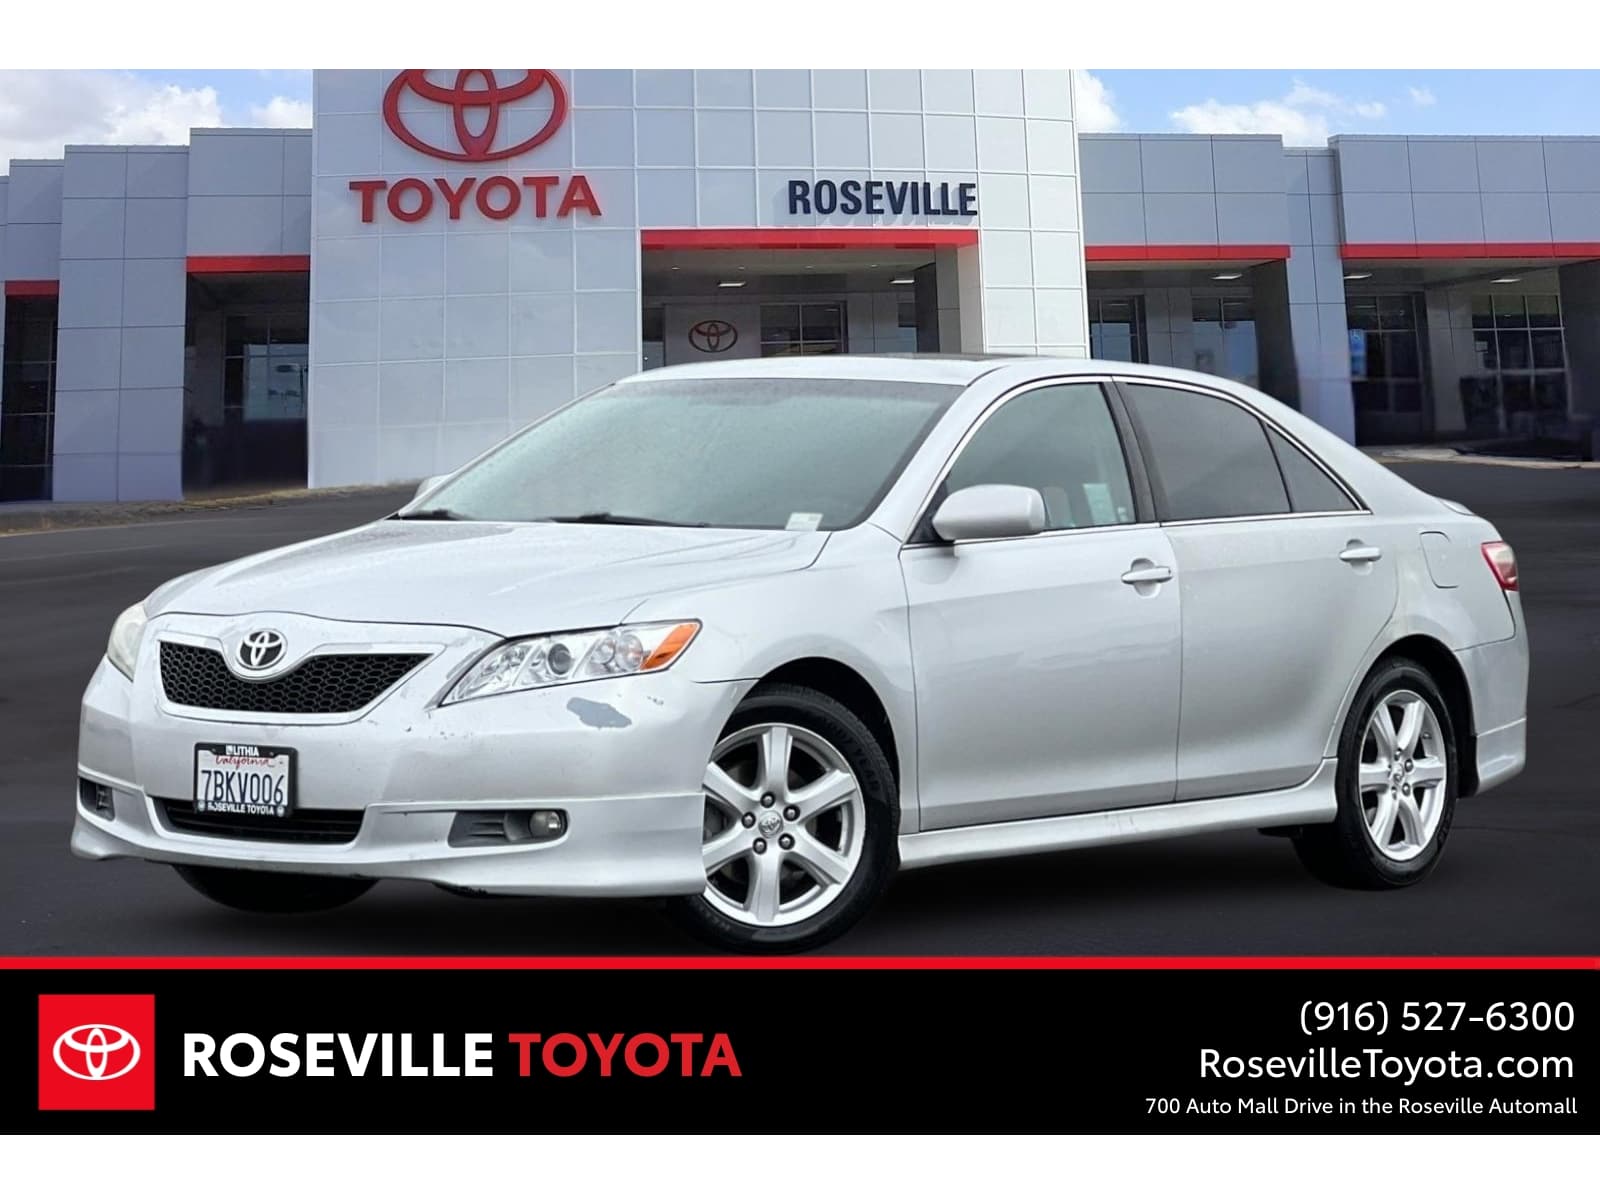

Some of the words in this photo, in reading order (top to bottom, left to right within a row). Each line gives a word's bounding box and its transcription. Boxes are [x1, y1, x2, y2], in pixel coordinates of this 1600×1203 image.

[349, 175, 602, 223] TOYOTA
[788, 180, 978, 215] ROSEVILLE
[233, 745, 260, 757] LITHIA
[201, 769, 285, 804] 7BKV006
[247, 805, 275, 816] TOYOTA
